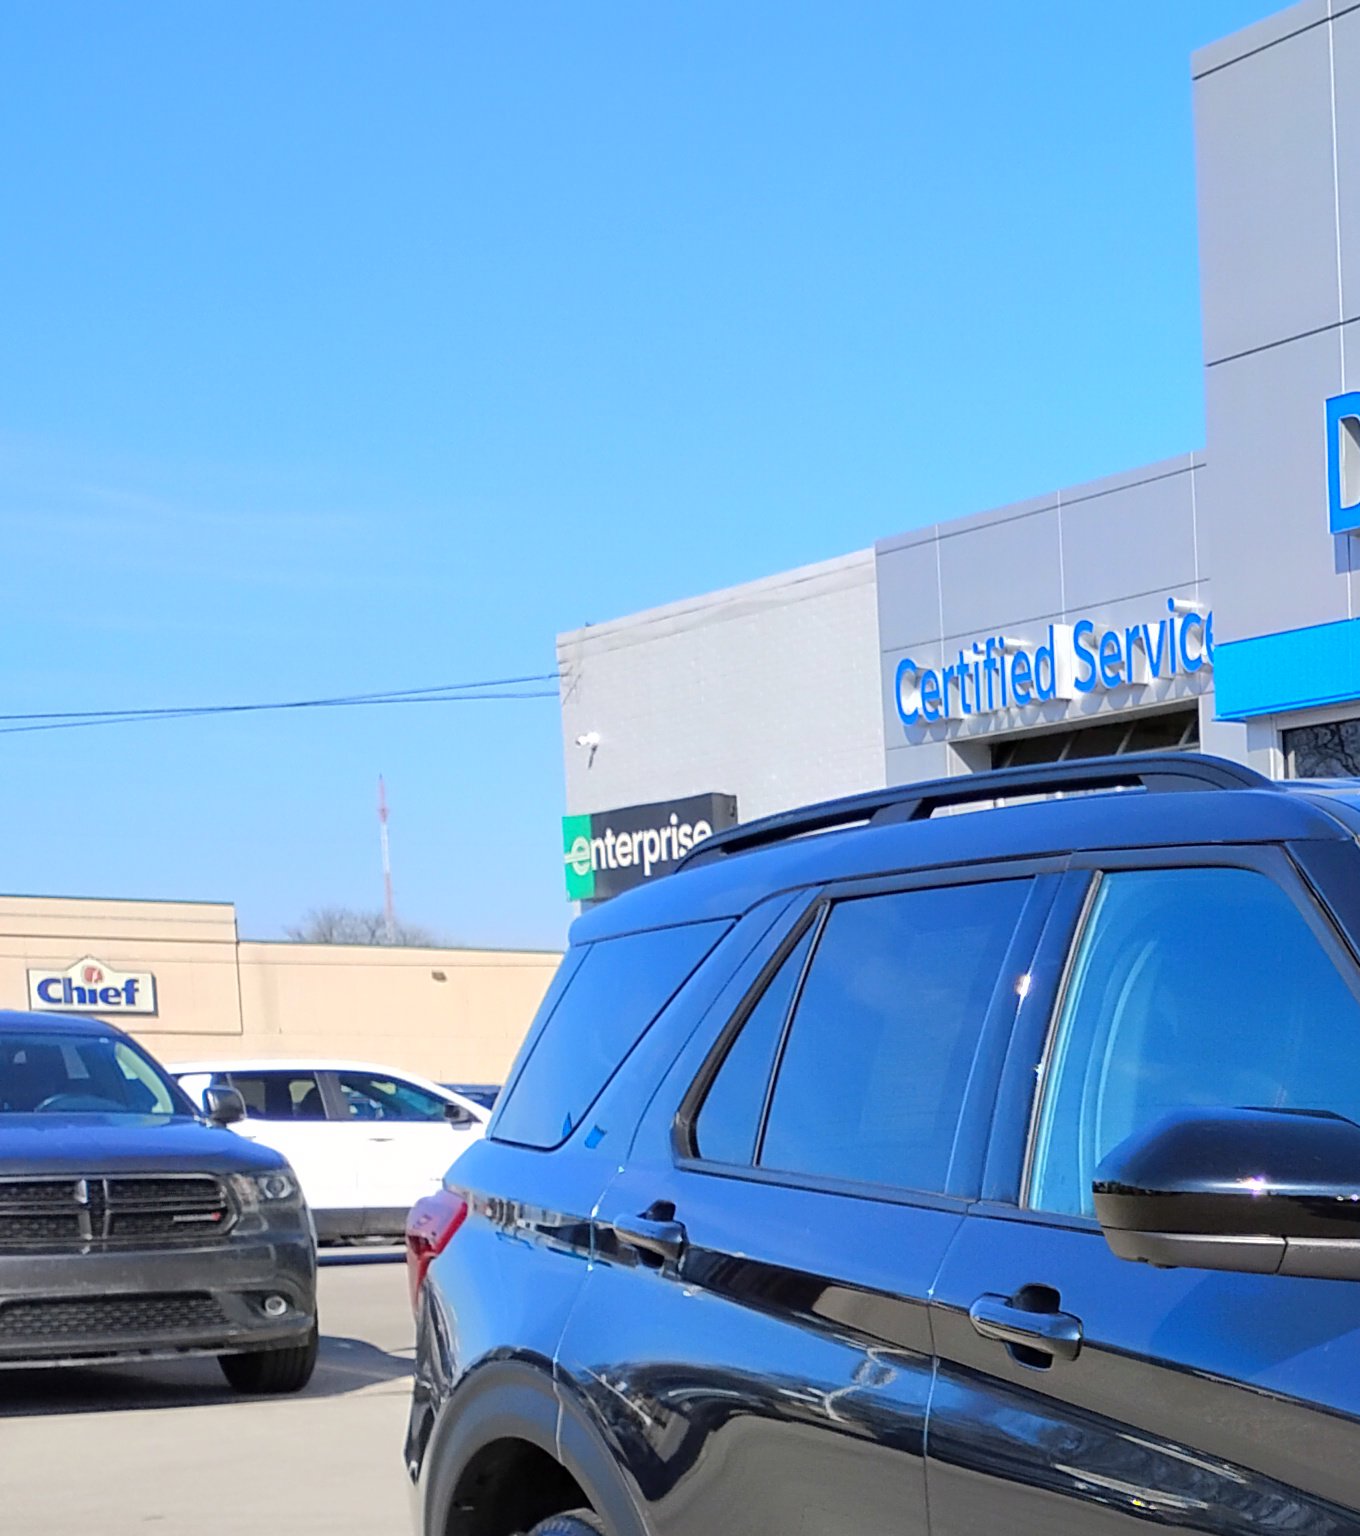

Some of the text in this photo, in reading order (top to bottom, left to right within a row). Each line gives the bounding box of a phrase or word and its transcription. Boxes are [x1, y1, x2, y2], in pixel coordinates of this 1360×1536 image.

[895, 623, 1058, 726] Certified
[564, 812, 713, 877] enterprise
[36, 977, 140, 1006] Chief
